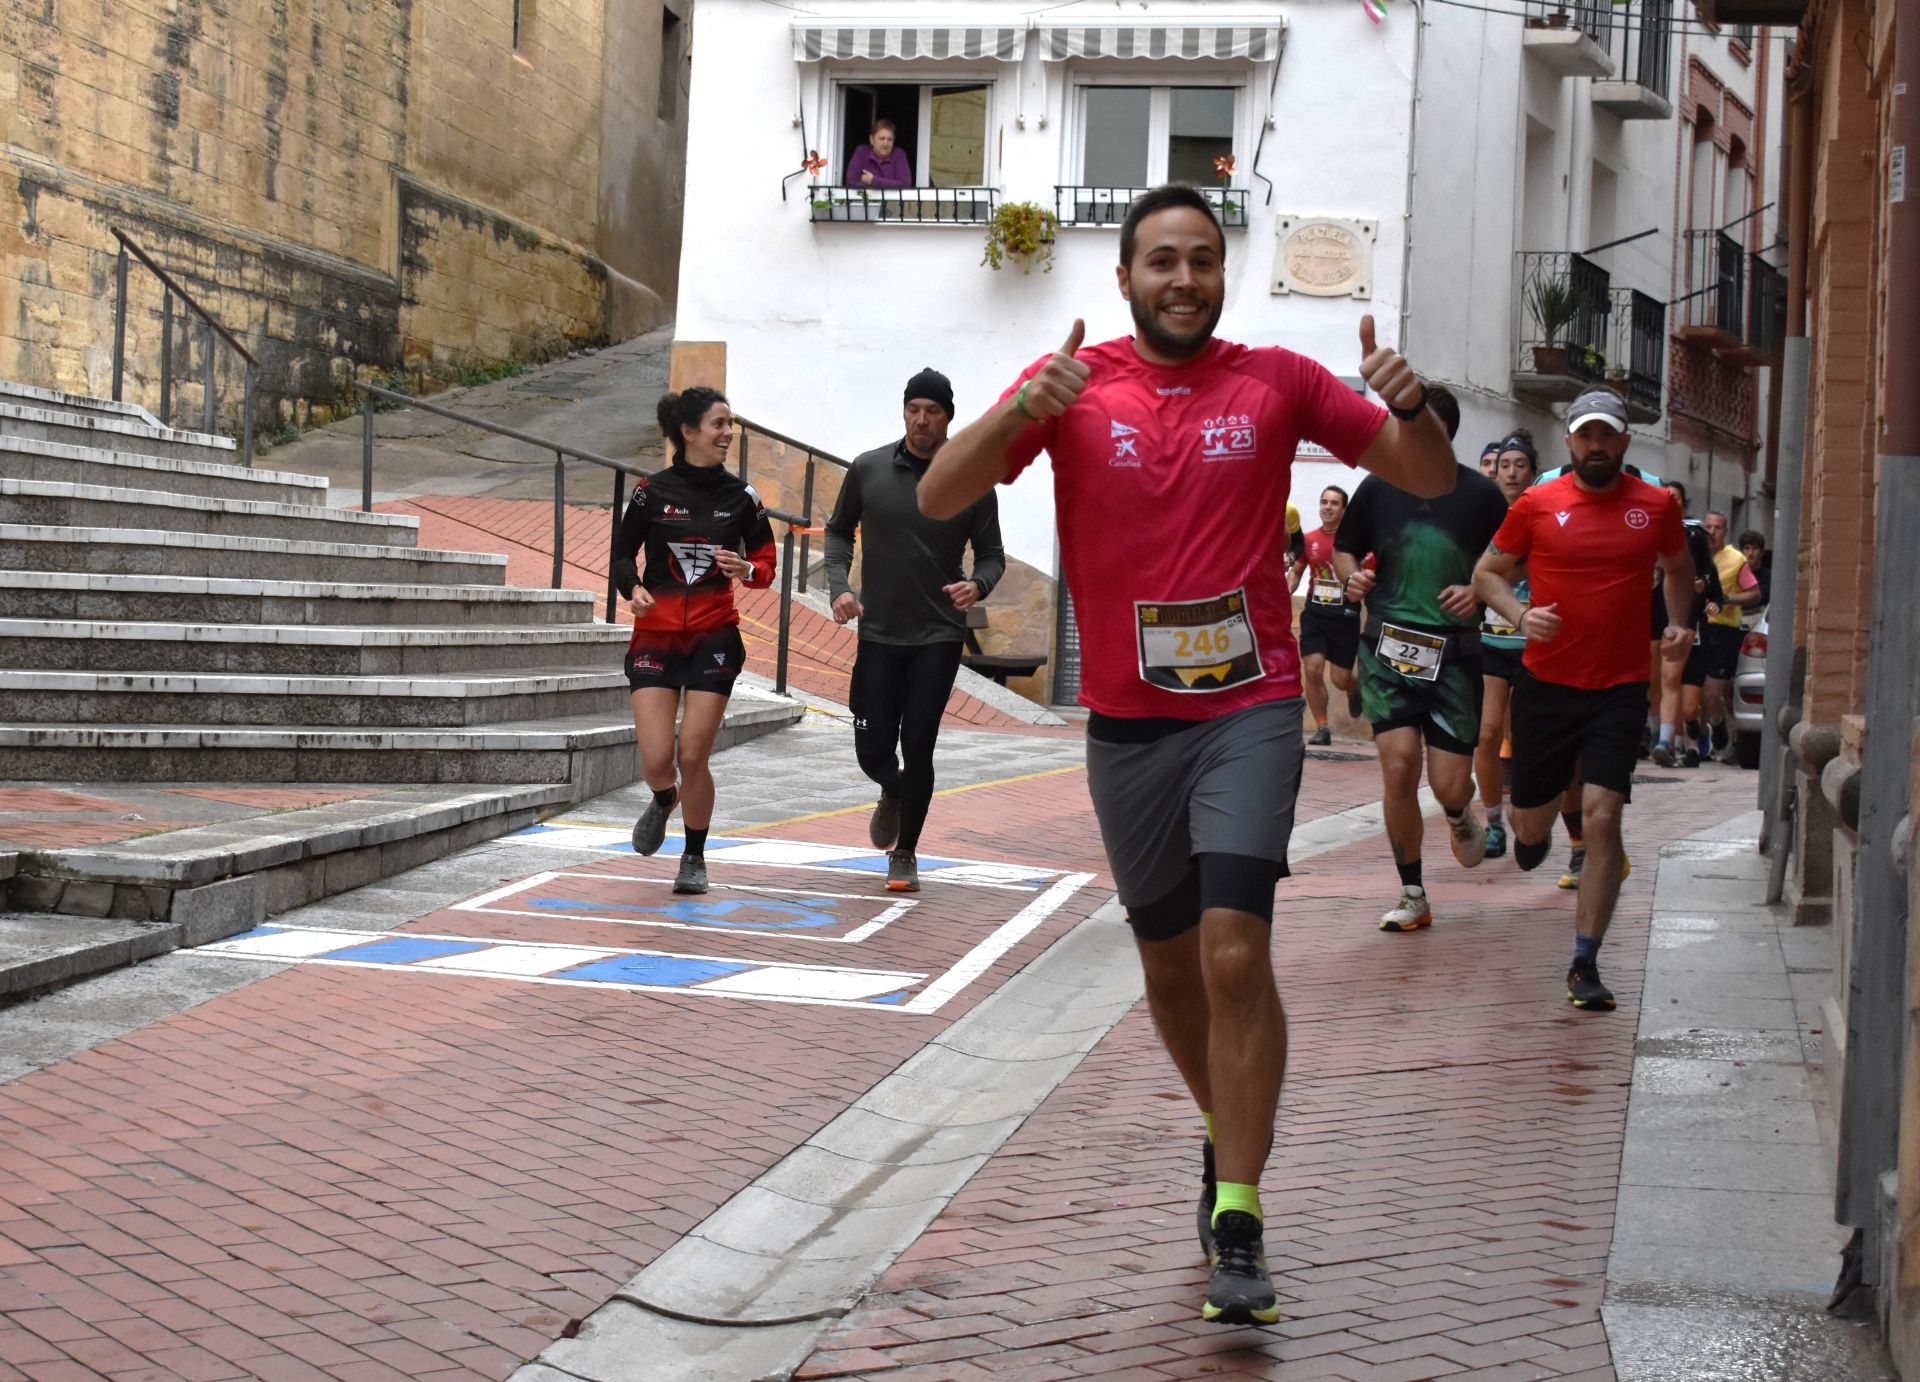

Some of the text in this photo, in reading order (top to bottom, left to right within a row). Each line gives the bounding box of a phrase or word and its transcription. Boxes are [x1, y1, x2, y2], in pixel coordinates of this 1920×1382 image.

[1230, 429, 1253, 449] 23
[1108, 459, 1142, 468] CaixaBank
[1173, 625, 1230, 657] 246
[1399, 644, 1419, 660] 22
